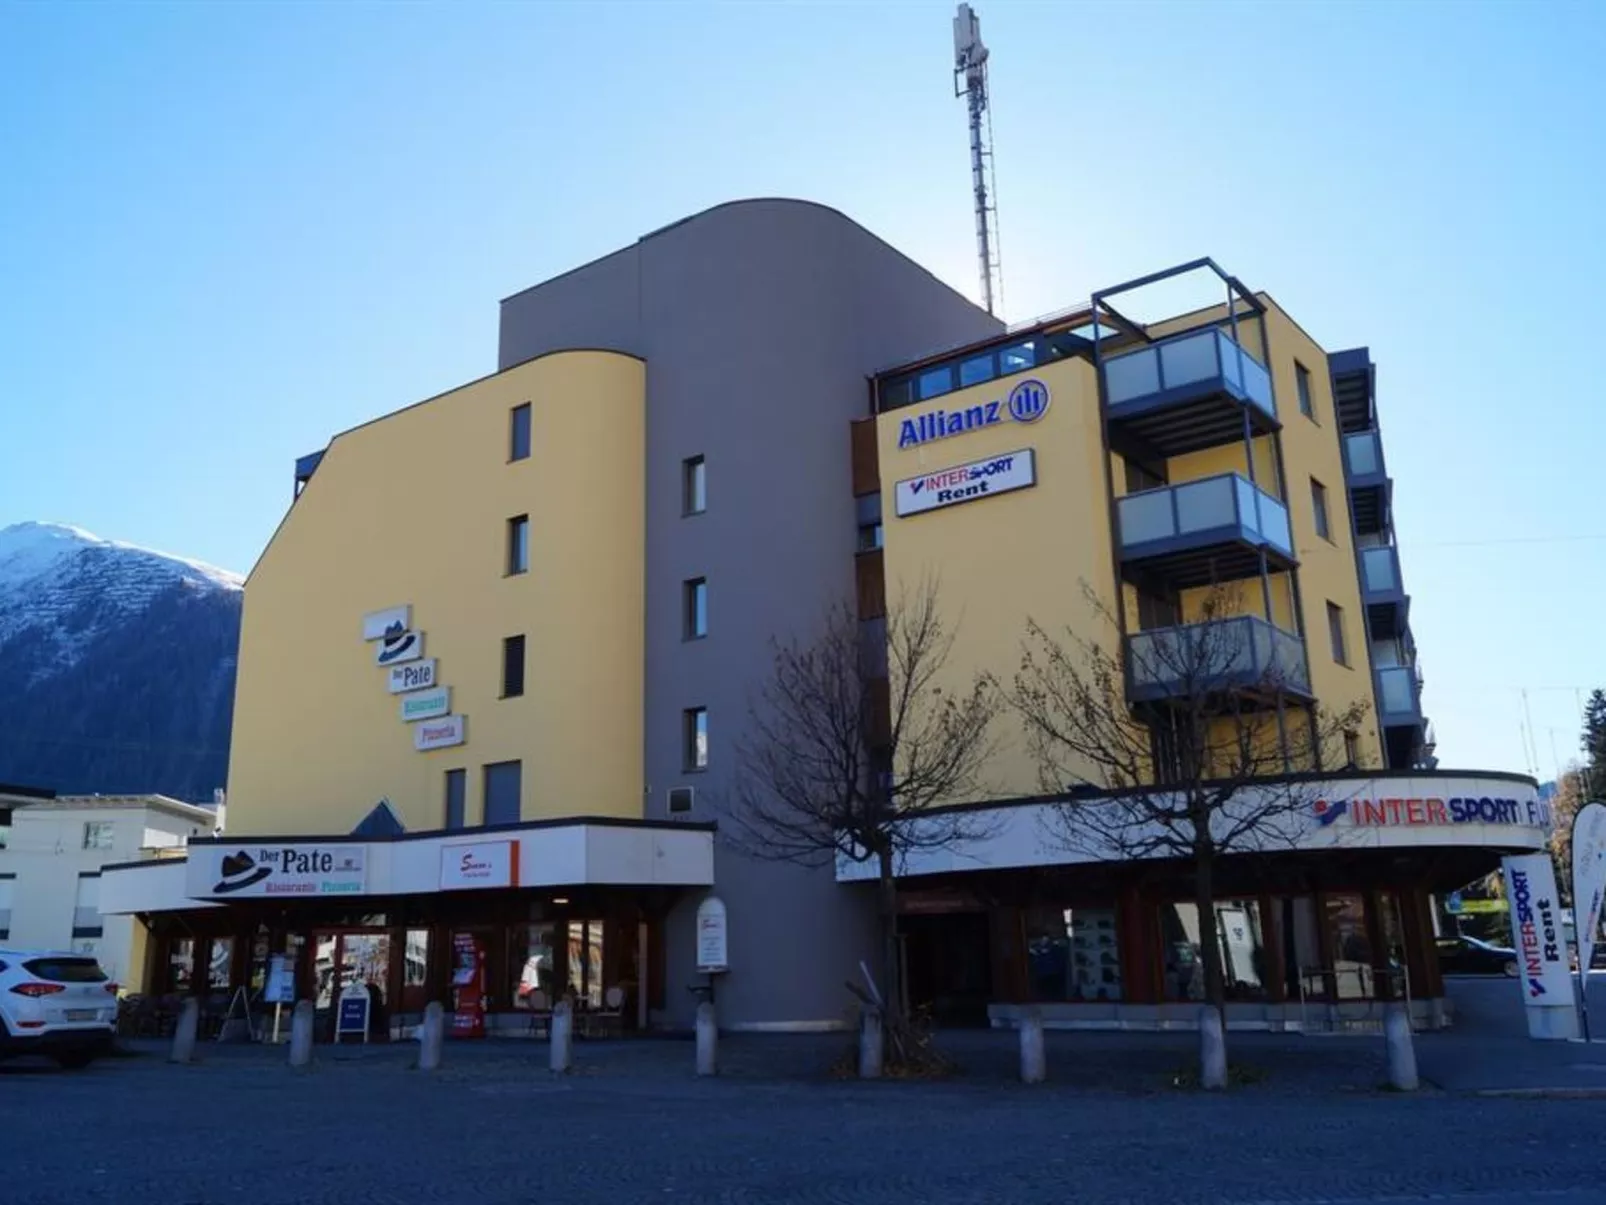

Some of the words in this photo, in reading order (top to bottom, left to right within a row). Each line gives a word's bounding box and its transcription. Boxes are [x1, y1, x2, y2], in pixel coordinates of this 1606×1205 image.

[898, 400, 1000, 448] Allianz
[925, 457, 1014, 491] INTERSPORT
[937, 480, 989, 503] Rent
[1352, 797, 1518, 827] INTERSPORT
[259, 849, 280, 862] Der
[281, 848, 333, 874] Pate
[1510, 868, 1543, 976] INTERSPORT
[1536, 897, 1560, 962] Rent
